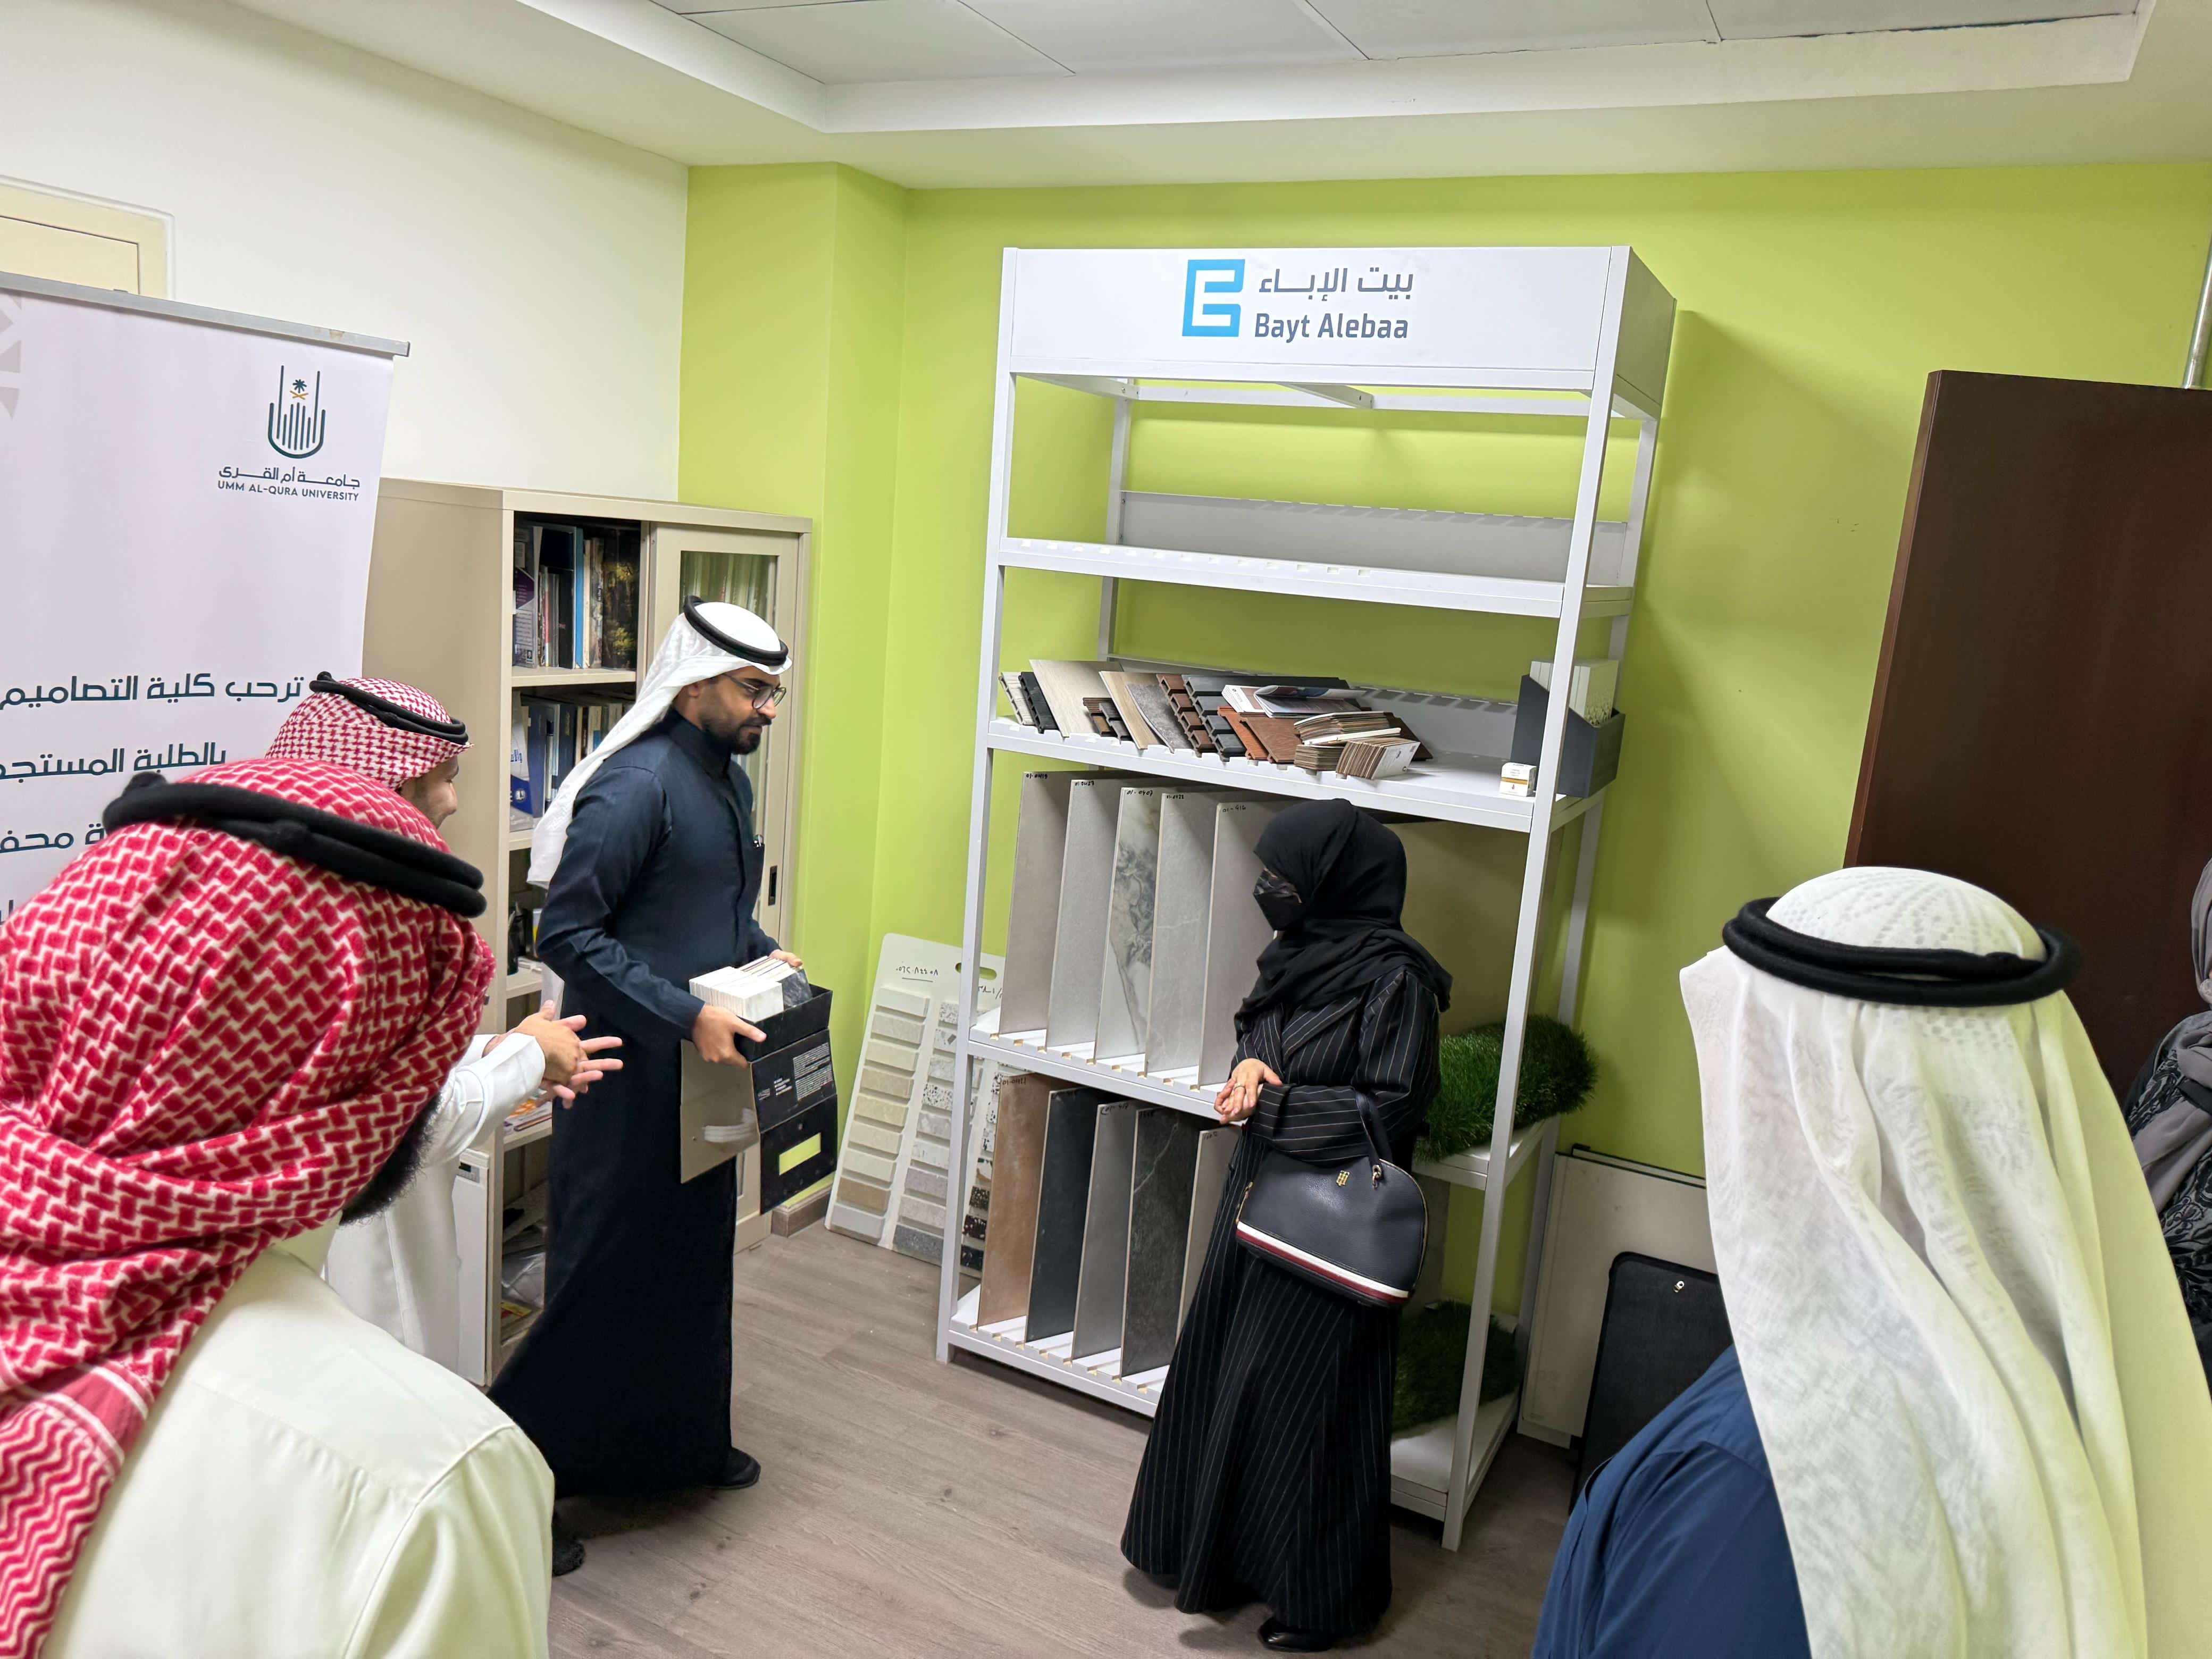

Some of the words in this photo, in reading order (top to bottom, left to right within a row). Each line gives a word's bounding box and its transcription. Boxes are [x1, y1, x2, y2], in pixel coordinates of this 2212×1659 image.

[1259, 267, 1348, 301] الإباء
[1358, 267, 1414, 300] بيت
[1254, 313, 1310, 343] Bayt
[1317, 313, 1408, 339] Alebaa
[219, 466, 279, 481] القرى
[280, 466, 296, 483] أم
[297, 471, 361, 490] جامعة
[217, 480, 245, 491] UMM
[249, 484, 298, 497] AL-QURA
[301, 489, 359, 501] UNIVERSITY
[0, 675, 138, 710] التصاميم
[147, 673, 215, 703] كلية
[225, 676, 305, 702] ترحب
[134, 742, 226, 773] بالطلبة
